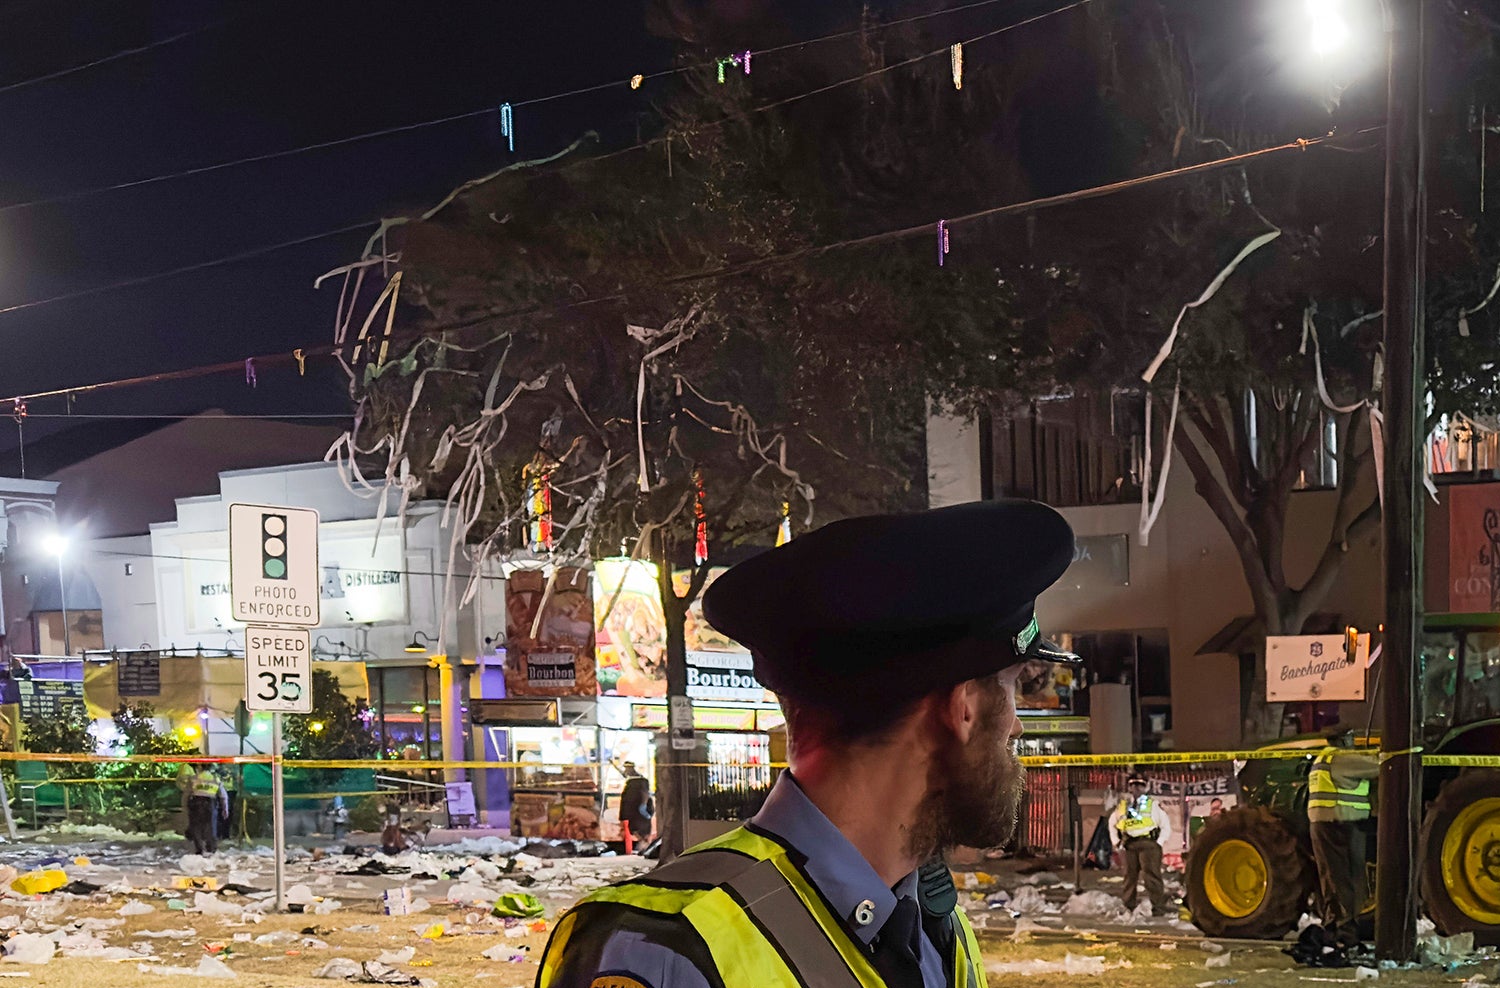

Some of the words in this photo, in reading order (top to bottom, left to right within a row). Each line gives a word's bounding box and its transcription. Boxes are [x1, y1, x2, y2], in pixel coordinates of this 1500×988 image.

[254, 585, 297, 600] PHOTO
[239, 602, 312, 618] ENFORCED
[251, 637, 305, 651] SPEED
[257, 655, 299, 668] LIMIT
[257, 671, 302, 702] 35
[855, 899, 876, 925] 6
